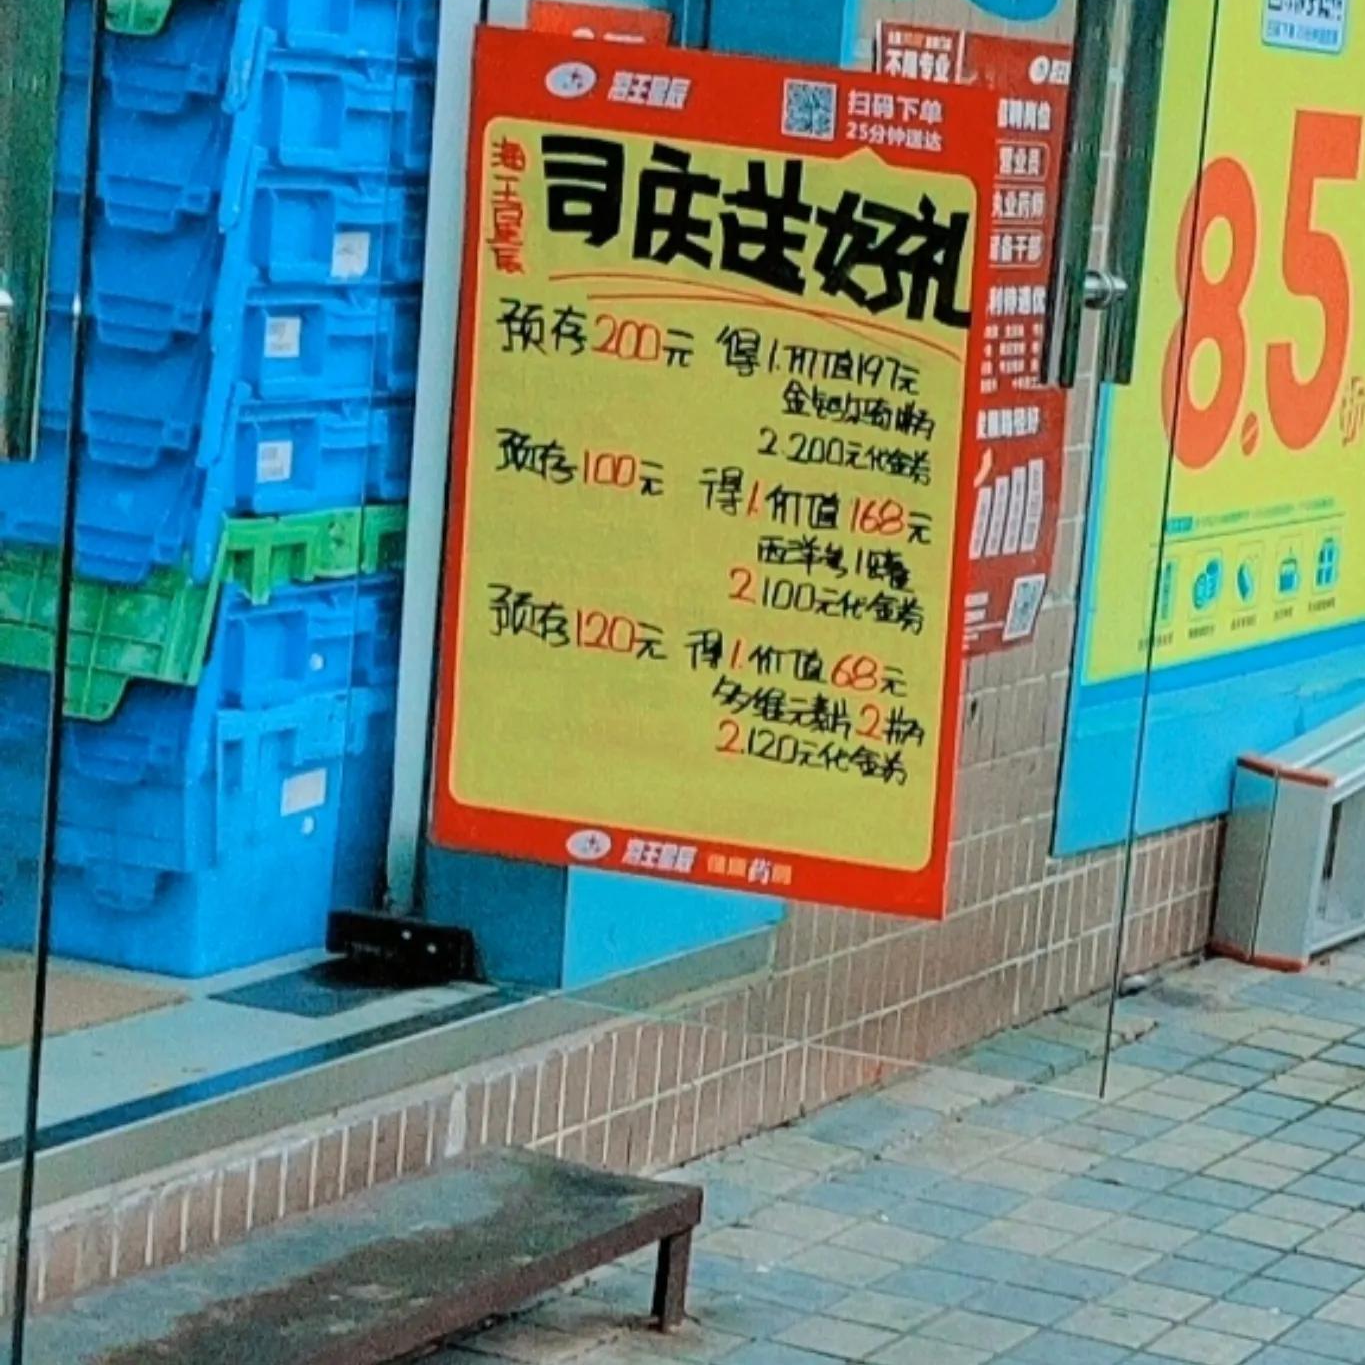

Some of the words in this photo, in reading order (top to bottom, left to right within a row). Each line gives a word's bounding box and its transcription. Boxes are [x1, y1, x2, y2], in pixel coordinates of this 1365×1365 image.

[607, 68, 693, 110] 海王星辰
[847, 88, 944, 126] 扫码下单
[846, 120, 943, 153] 25分钟送达
[541, 133, 972, 331] 司庆送好礼
[496, 297, 695, 368] 预存200元
[495, 427, 665, 498] 预存100元
[489, 583, 668, 661] 预存120元
[620, 837, 698, 872] 海王星辰
